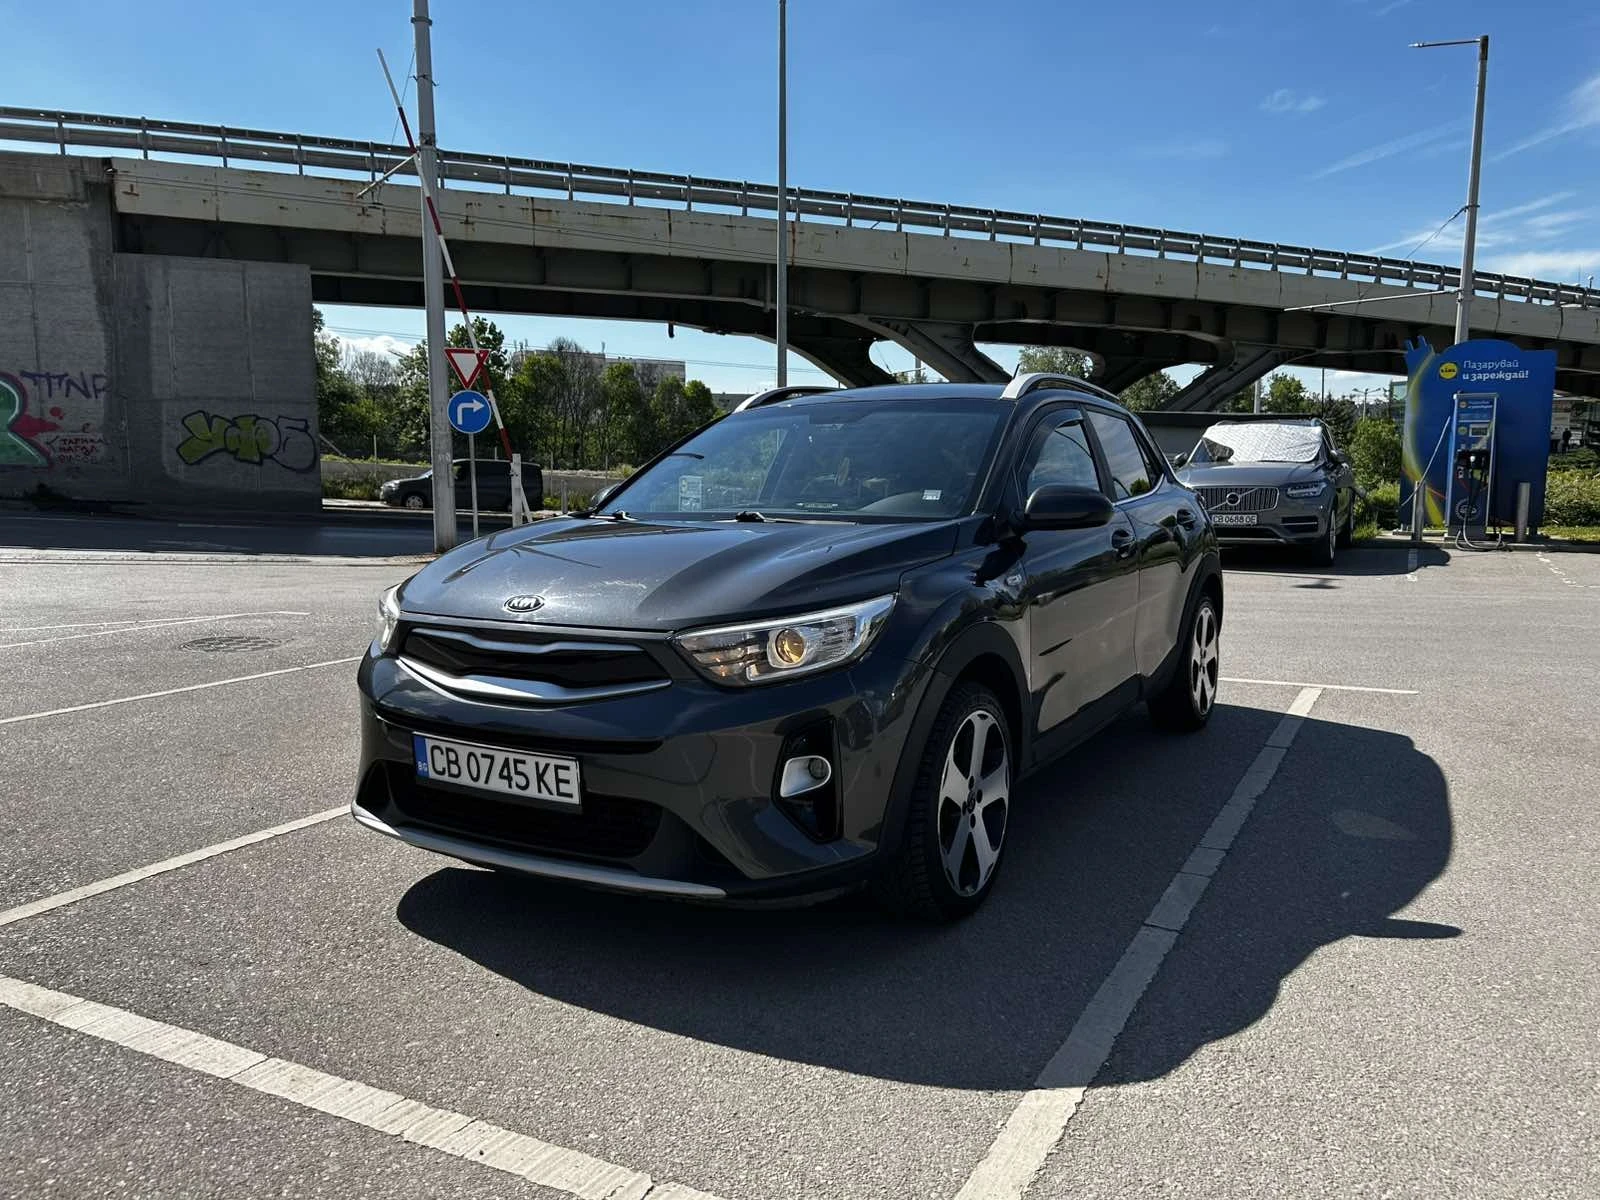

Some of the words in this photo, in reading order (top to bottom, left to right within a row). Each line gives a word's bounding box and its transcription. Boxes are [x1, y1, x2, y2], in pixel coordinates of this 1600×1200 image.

[1463, 359, 1519, 370] Пазарувай
[1471, 370, 1529, 381] зареждай!
[430, 744, 462, 779] CB
[467, 751, 530, 792] 0745
[535, 761, 574, 799] KE
